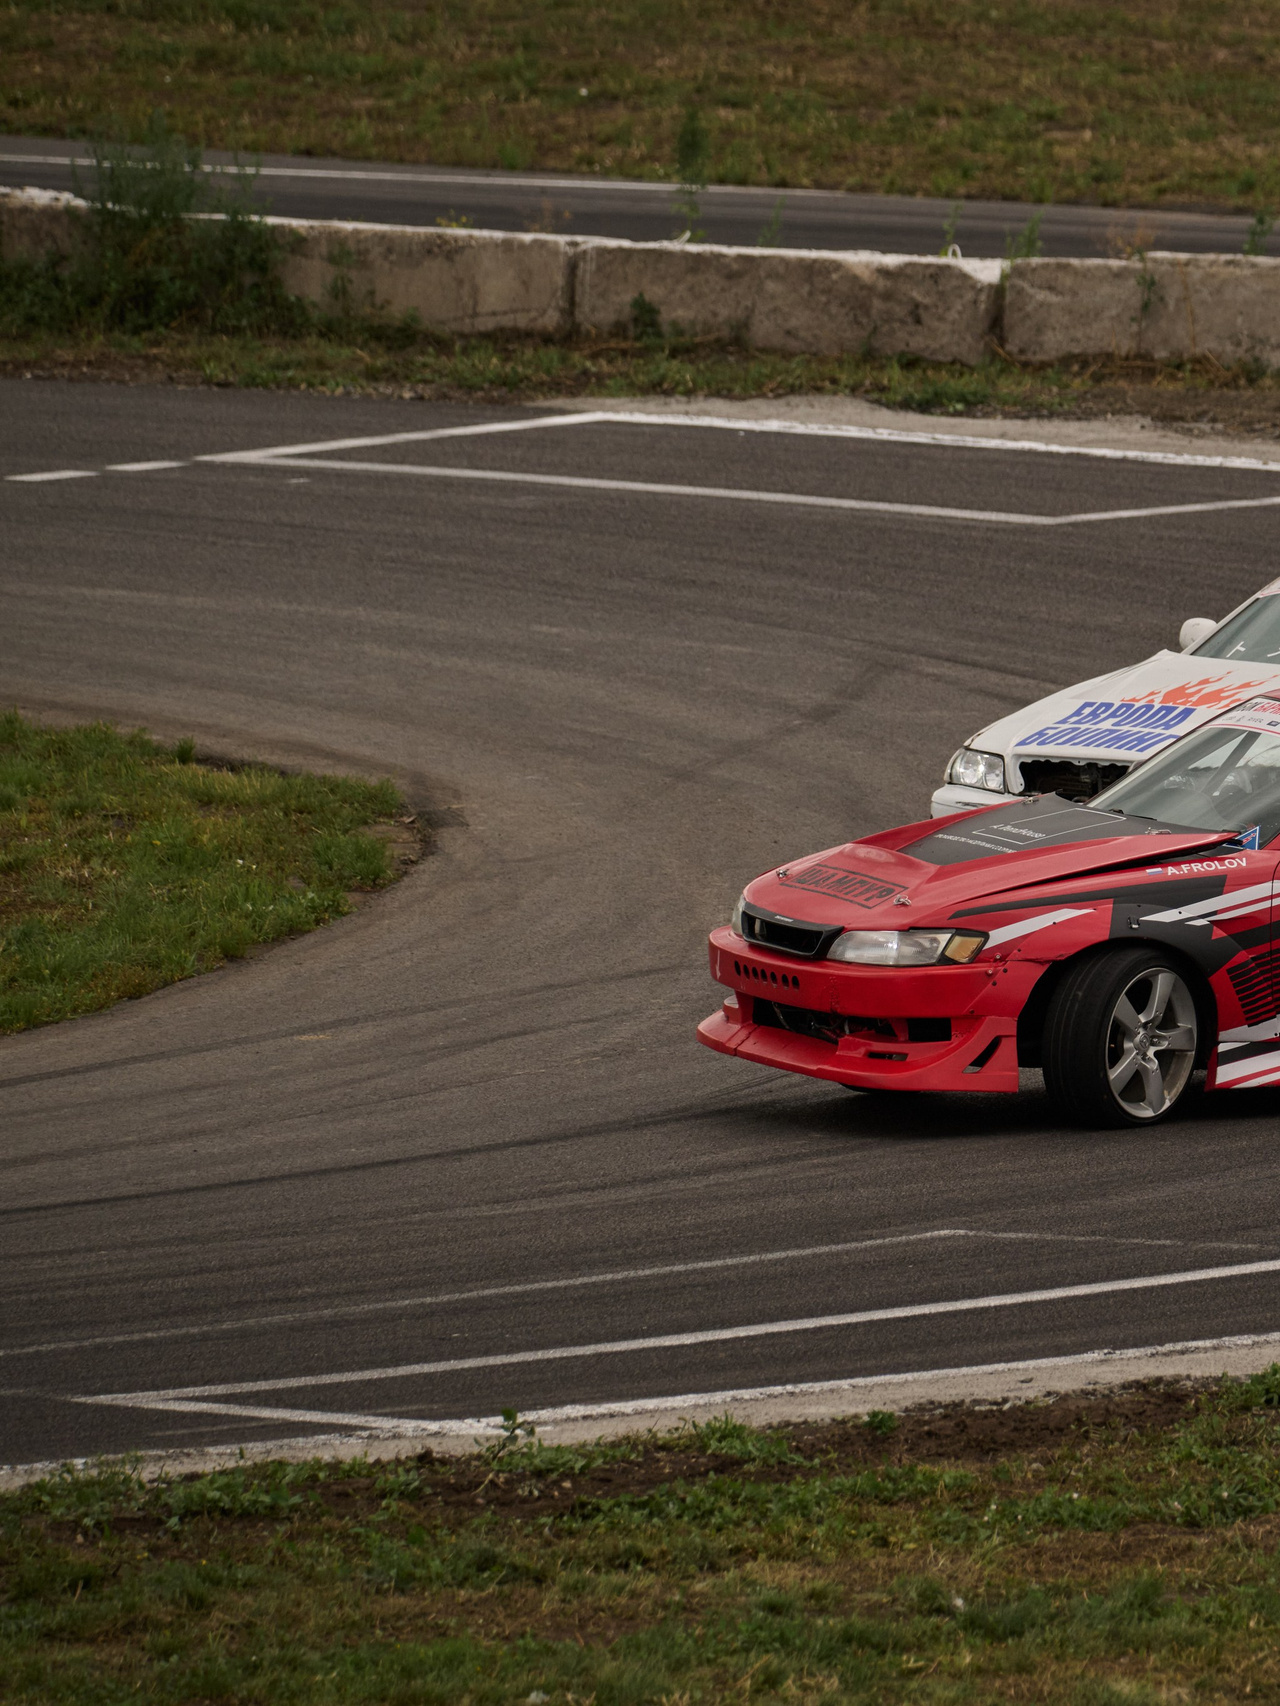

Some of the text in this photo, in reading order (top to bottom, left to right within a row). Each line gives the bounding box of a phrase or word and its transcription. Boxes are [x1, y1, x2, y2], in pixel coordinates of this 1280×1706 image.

[1053, 701, 1198, 731] ЕВРОПА
[1015, 726, 1182, 754] БОУЛИНГ
[1167, 857, 1248, 876] A.FROLOV
[791, 867, 897, 902] ШАМПУР
